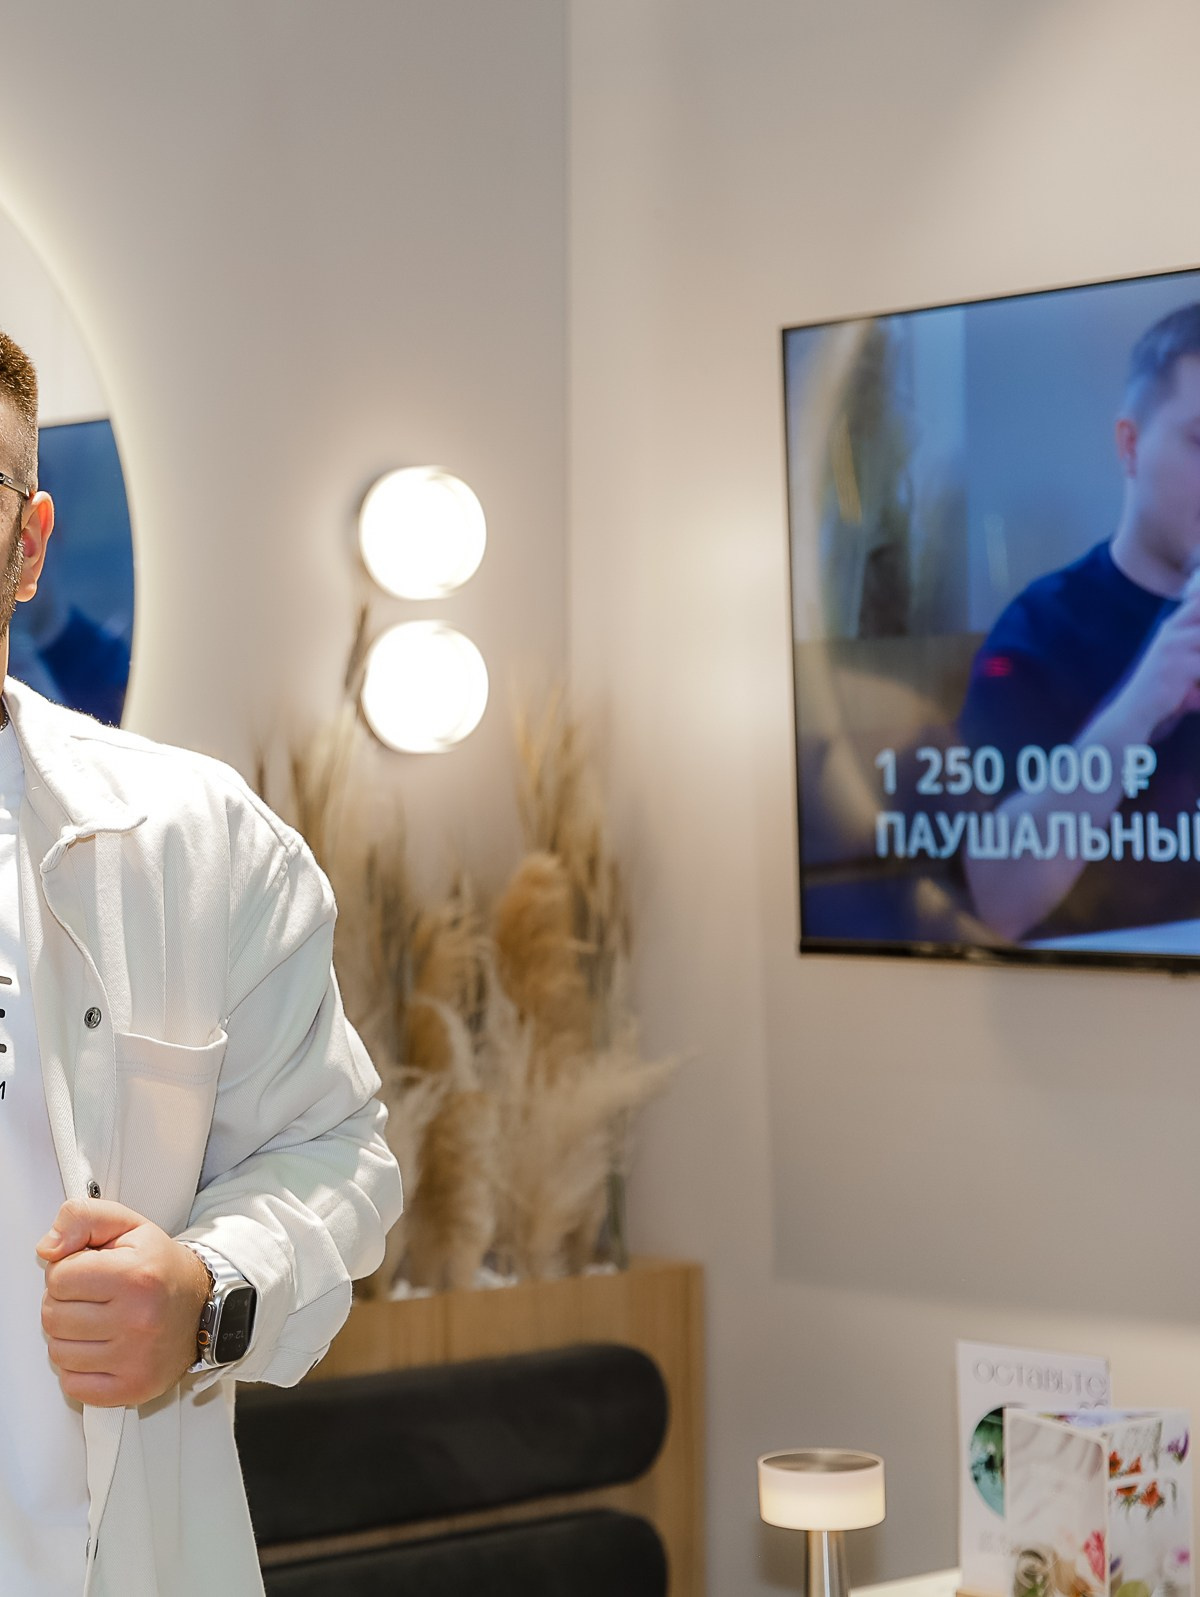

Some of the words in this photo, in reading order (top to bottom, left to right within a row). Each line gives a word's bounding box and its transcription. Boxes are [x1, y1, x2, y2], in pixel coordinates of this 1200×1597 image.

[875, 748, 897, 795] 1
[916, 745, 1005, 795] 250
[1016, 744, 1113, 795] 000
[875, 798, 1200, 863] ПАУШАЛЬНЫ
